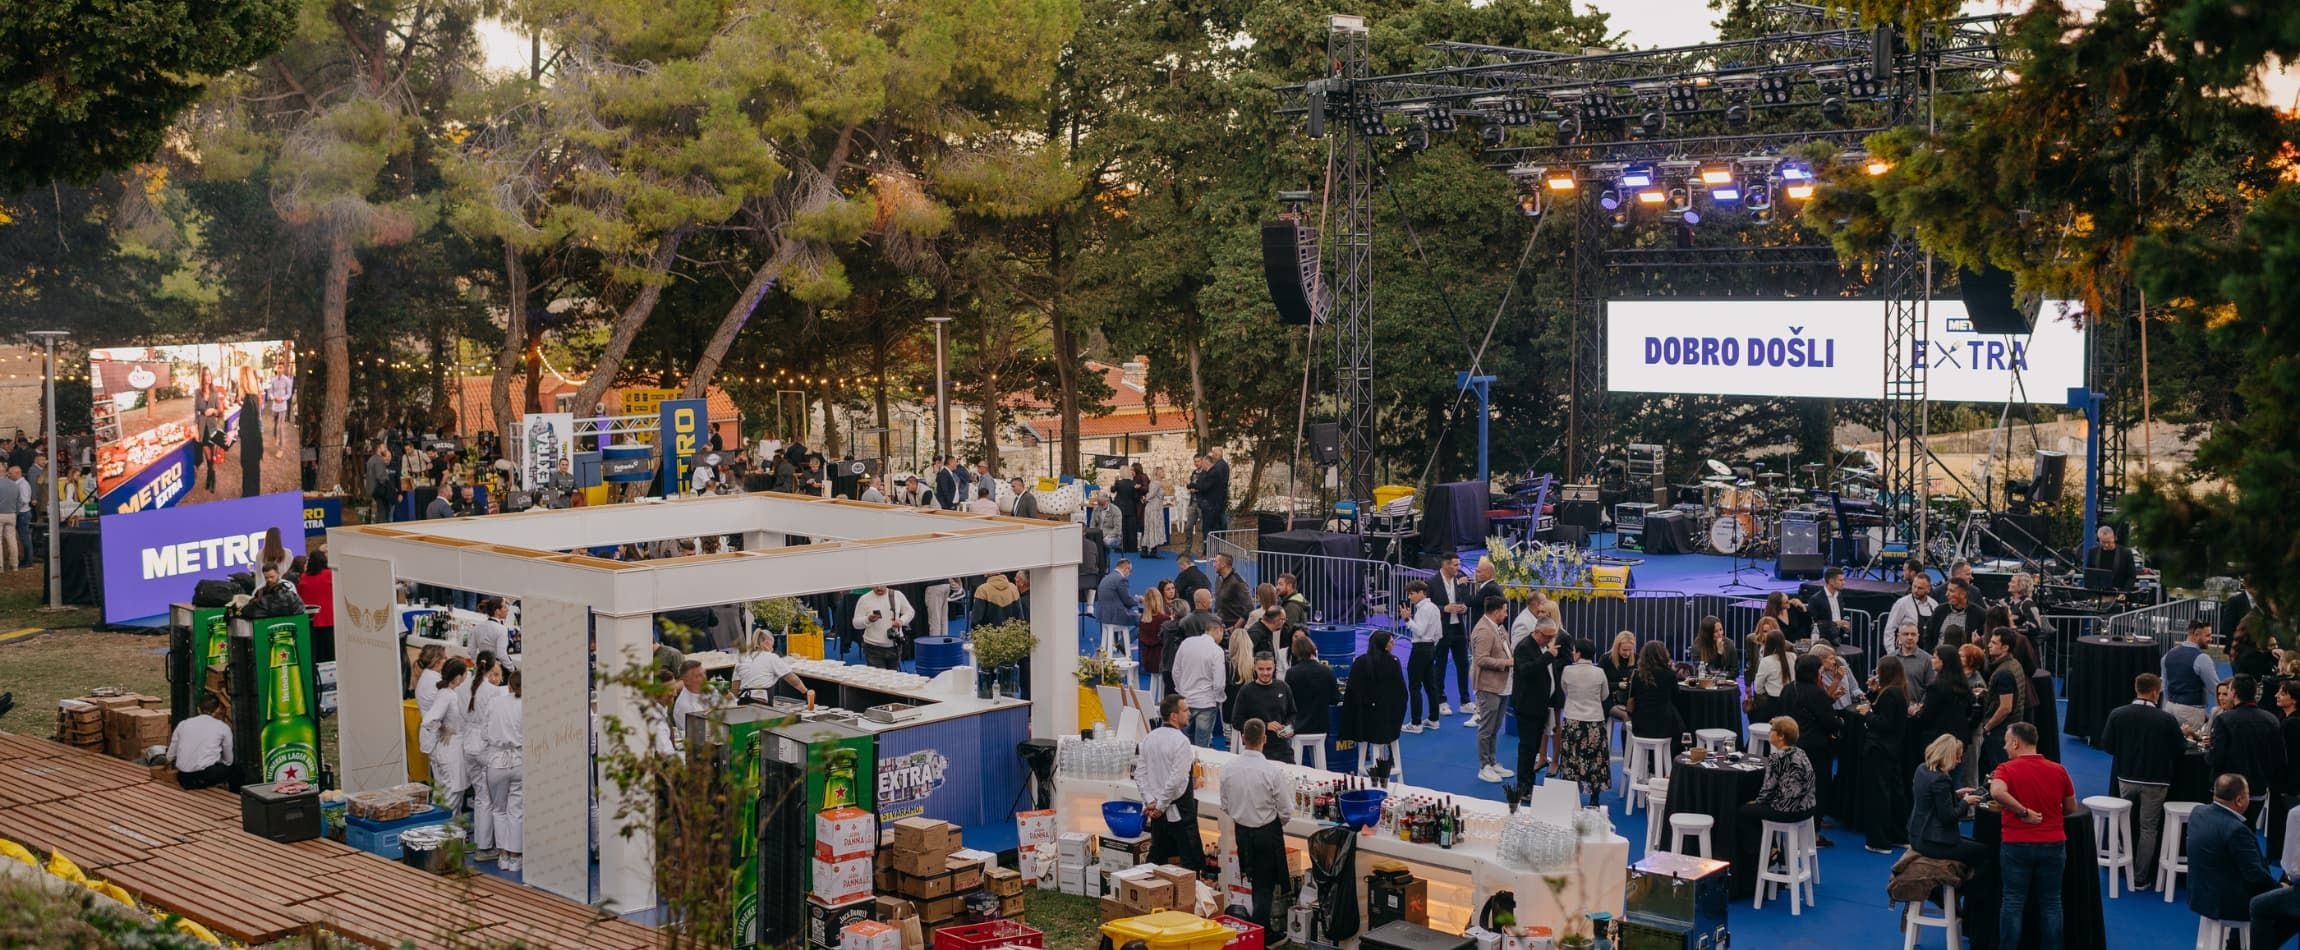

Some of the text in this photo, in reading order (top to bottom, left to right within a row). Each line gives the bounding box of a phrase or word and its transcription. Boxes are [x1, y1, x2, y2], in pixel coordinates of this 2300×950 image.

[1644, 326, 1835, 368] DOBRO DOŠLI
[536, 432, 550, 484] EXTRA
[118, 461, 183, 515] METRO
[1882, 551, 1908, 559] METRO
[1599, 576, 1620, 584] METRO
[287, 752, 306, 764] LAGER
[878, 763, 934, 793] EXTRA
[843, 837, 865, 847] PANNA
